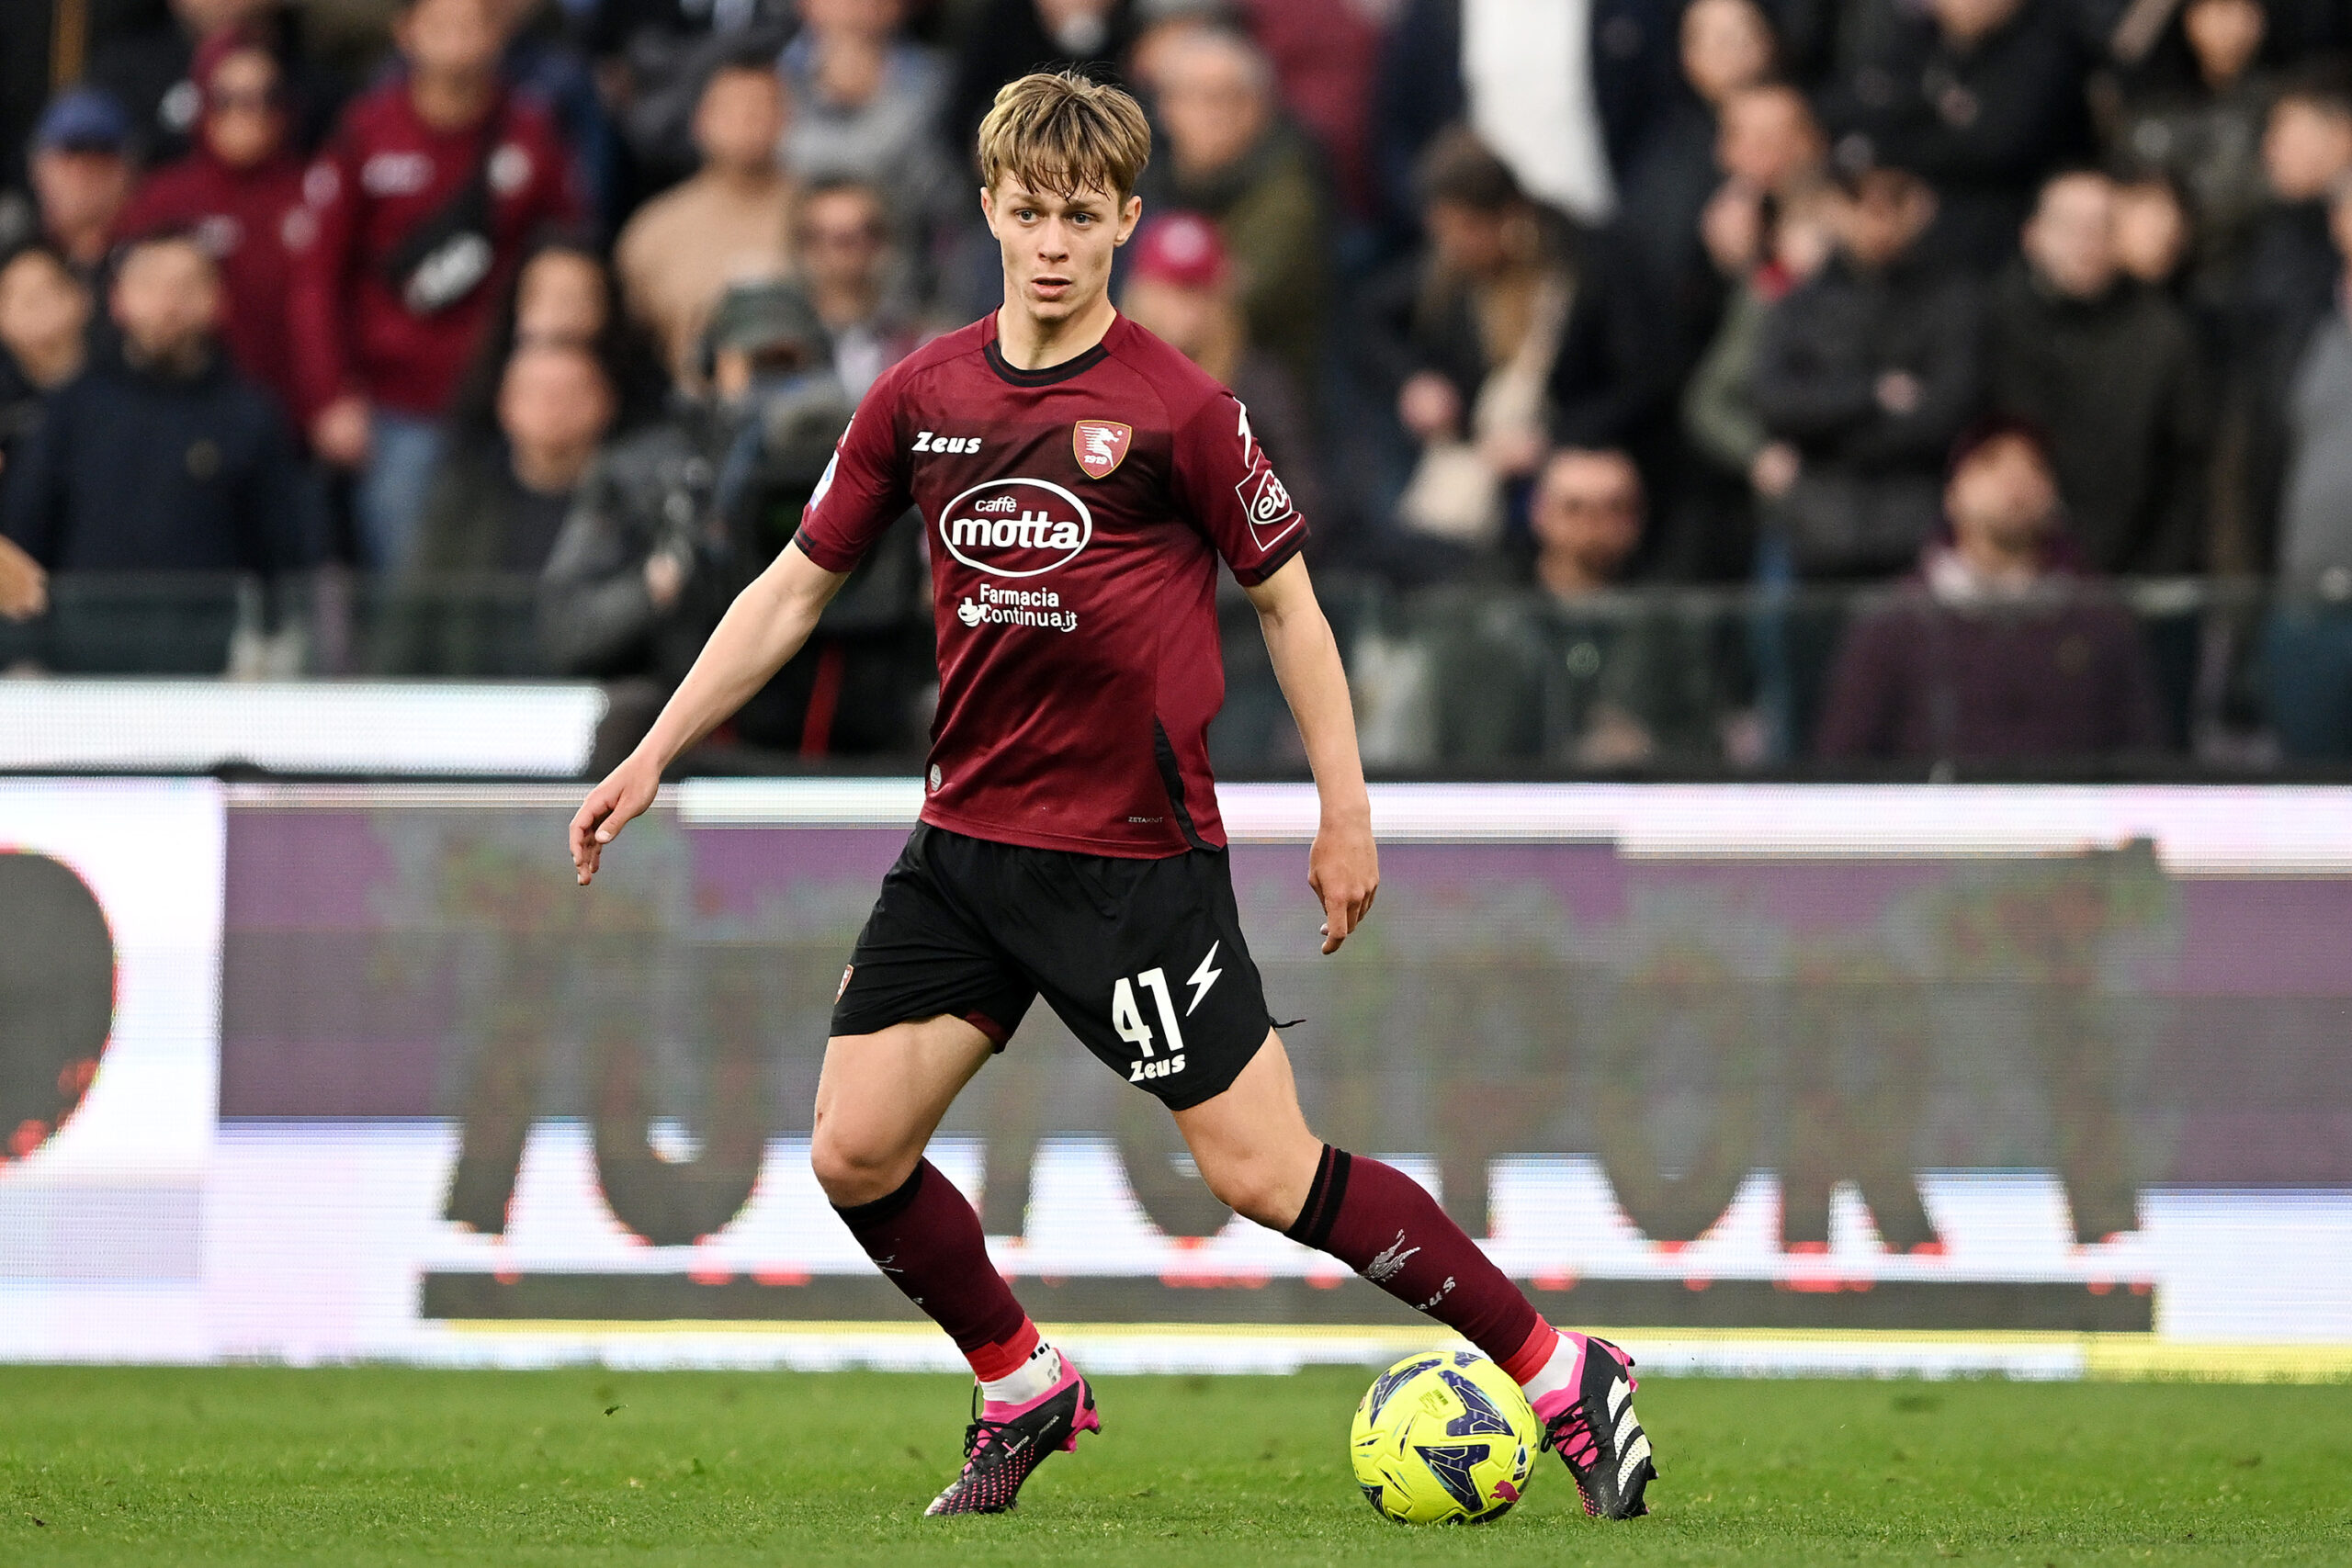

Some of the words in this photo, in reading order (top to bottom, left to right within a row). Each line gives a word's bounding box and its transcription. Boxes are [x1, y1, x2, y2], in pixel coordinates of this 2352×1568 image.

[911, 432, 982, 454] Zeus
[975, 495, 1017, 513] caffè
[952, 511, 1080, 549] motta
[979, 583, 1059, 607] Farmacia
[979, 604, 1078, 632] Continua.it
[1113, 967, 1184, 1058] 41
[1128, 1054, 1186, 1082] Zeus
